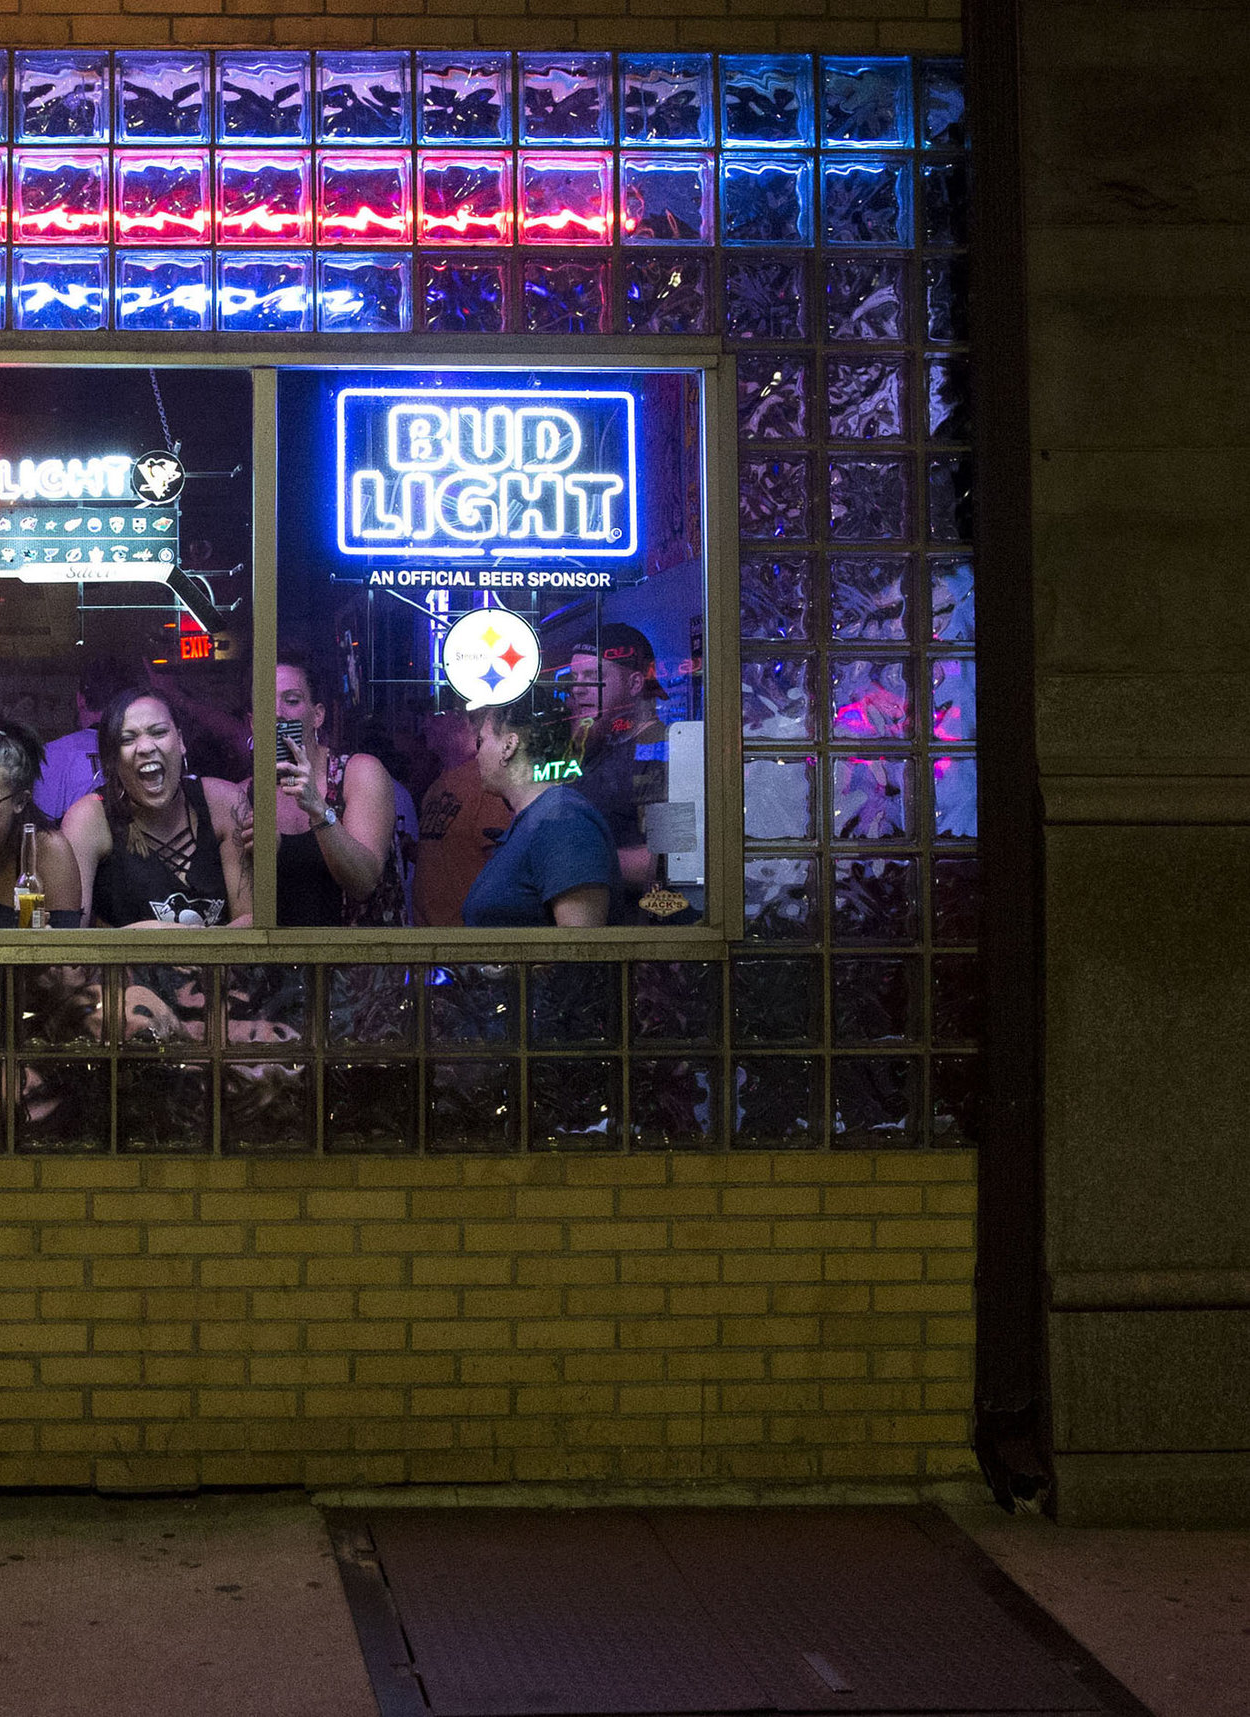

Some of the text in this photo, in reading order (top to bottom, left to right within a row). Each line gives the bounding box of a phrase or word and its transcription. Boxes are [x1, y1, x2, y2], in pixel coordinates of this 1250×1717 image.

[387, 404, 582, 472] BUD
[352, 470, 624, 540] LIGHT
[369, 570, 612, 587] AN OFFICIAL BEER SPONSOR
[180, 635, 210, 659] EXIT
[644, 901, 684, 909] JACK'S
